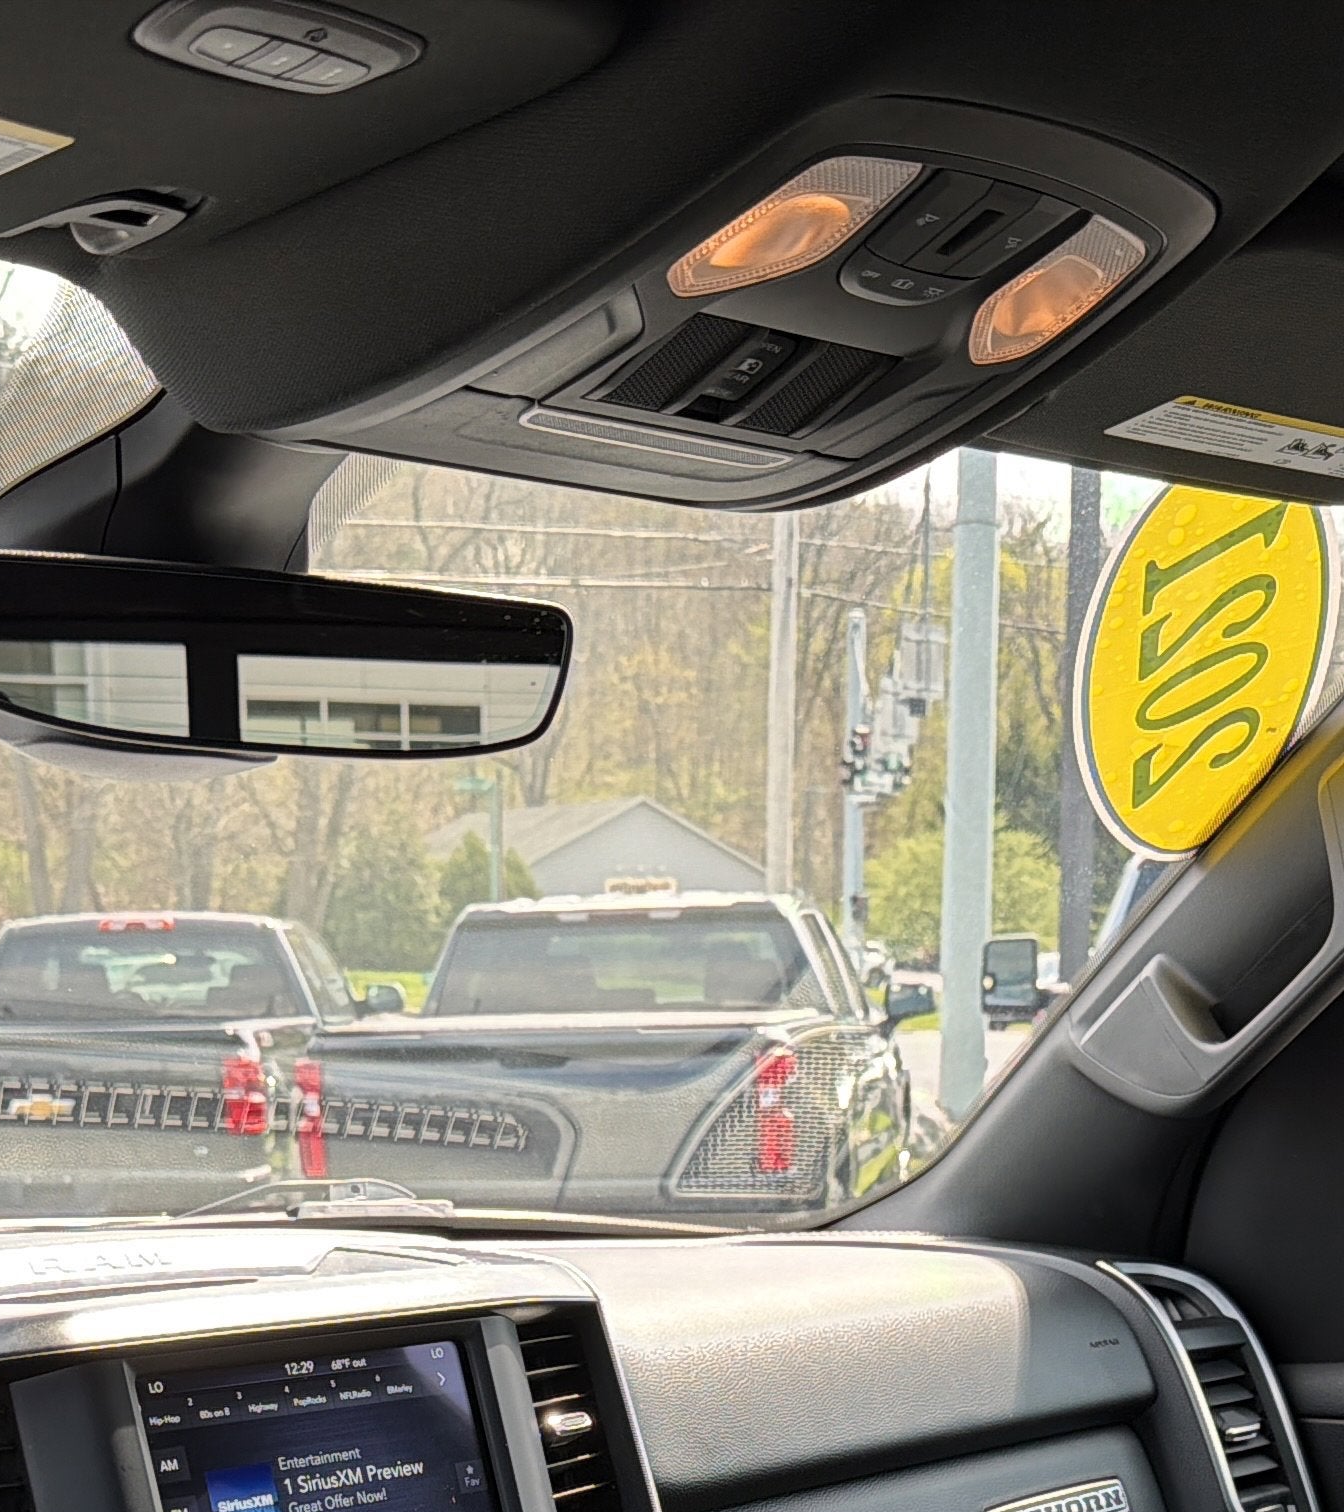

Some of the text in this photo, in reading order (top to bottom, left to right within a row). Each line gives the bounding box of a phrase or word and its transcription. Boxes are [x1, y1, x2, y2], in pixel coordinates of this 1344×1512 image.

[284, 1361, 314, 1376] 12:29
[148, 1381, 164, 1394] LO
[160, 1458, 179, 1473] AM
[277, 1448, 362, 1472] Entertainment
[283, 1460, 424, 1495] 1 SiriusXM Preview
[464, 1476, 480, 1488] Fav
[324, 1493, 355, 1510] Offer
[356, 1487, 389, 1505] Now!
